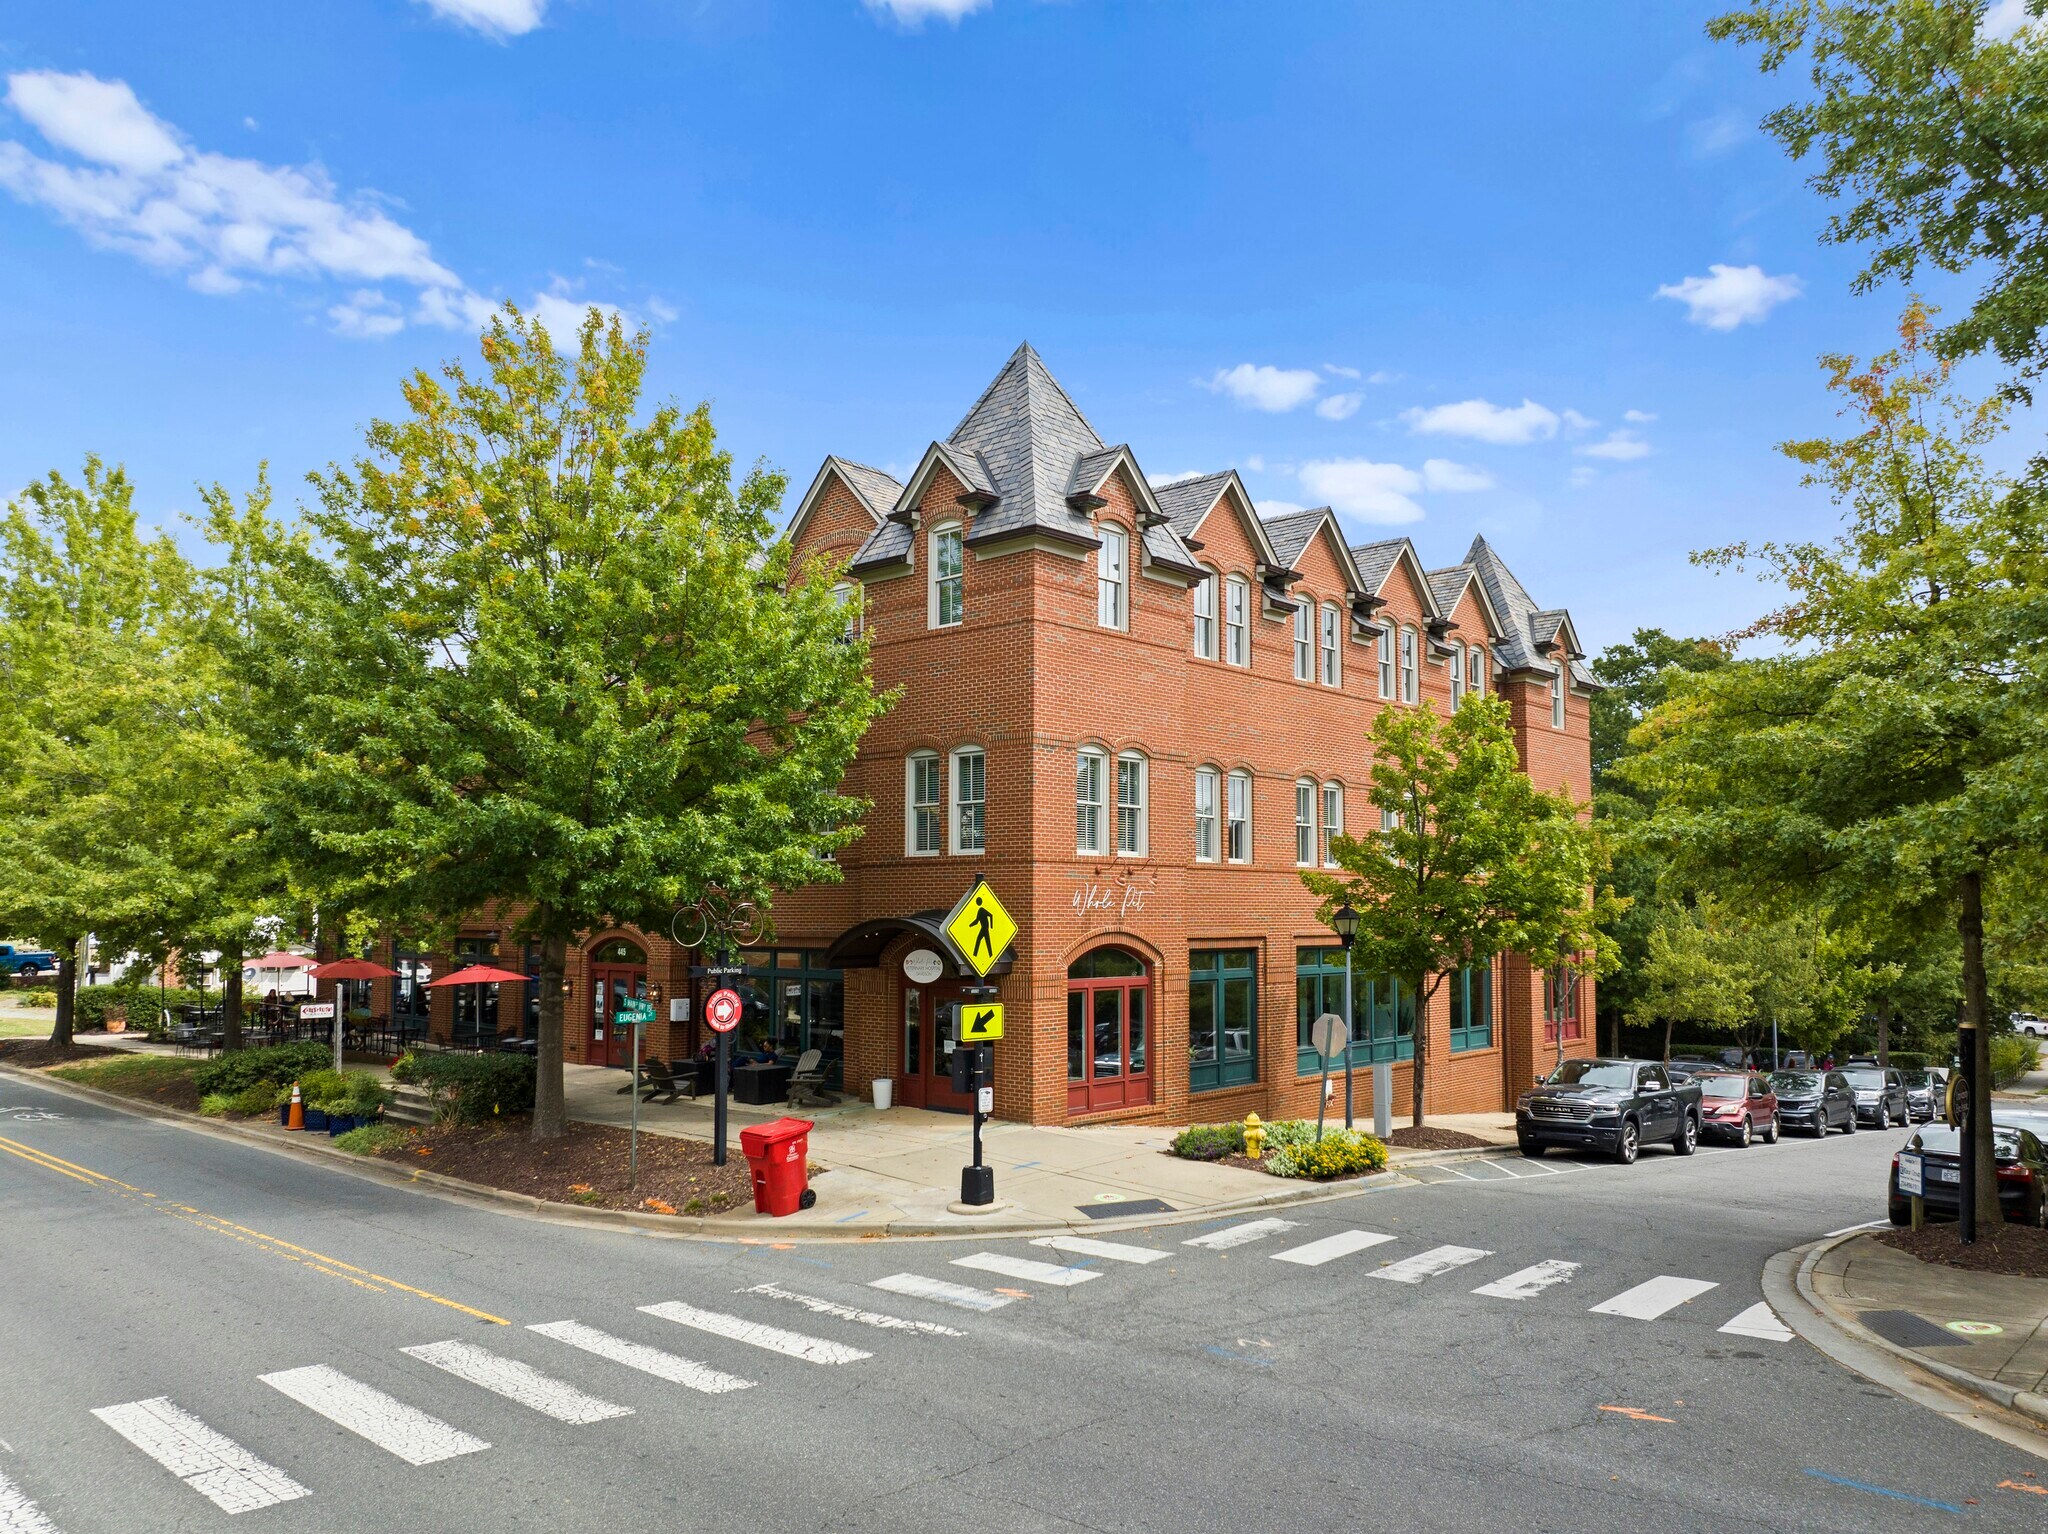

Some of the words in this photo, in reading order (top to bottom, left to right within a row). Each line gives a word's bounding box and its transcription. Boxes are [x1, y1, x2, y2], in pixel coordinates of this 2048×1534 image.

[1072, 882, 1115, 917] Whole
[1121, 884, 1154, 918] Pet
[723, 966, 742, 974] Parking
[709, 993, 723, 1009] Public
[723, 991, 740, 1008] Parking
[619, 1012, 647, 1022] EUGENIA
